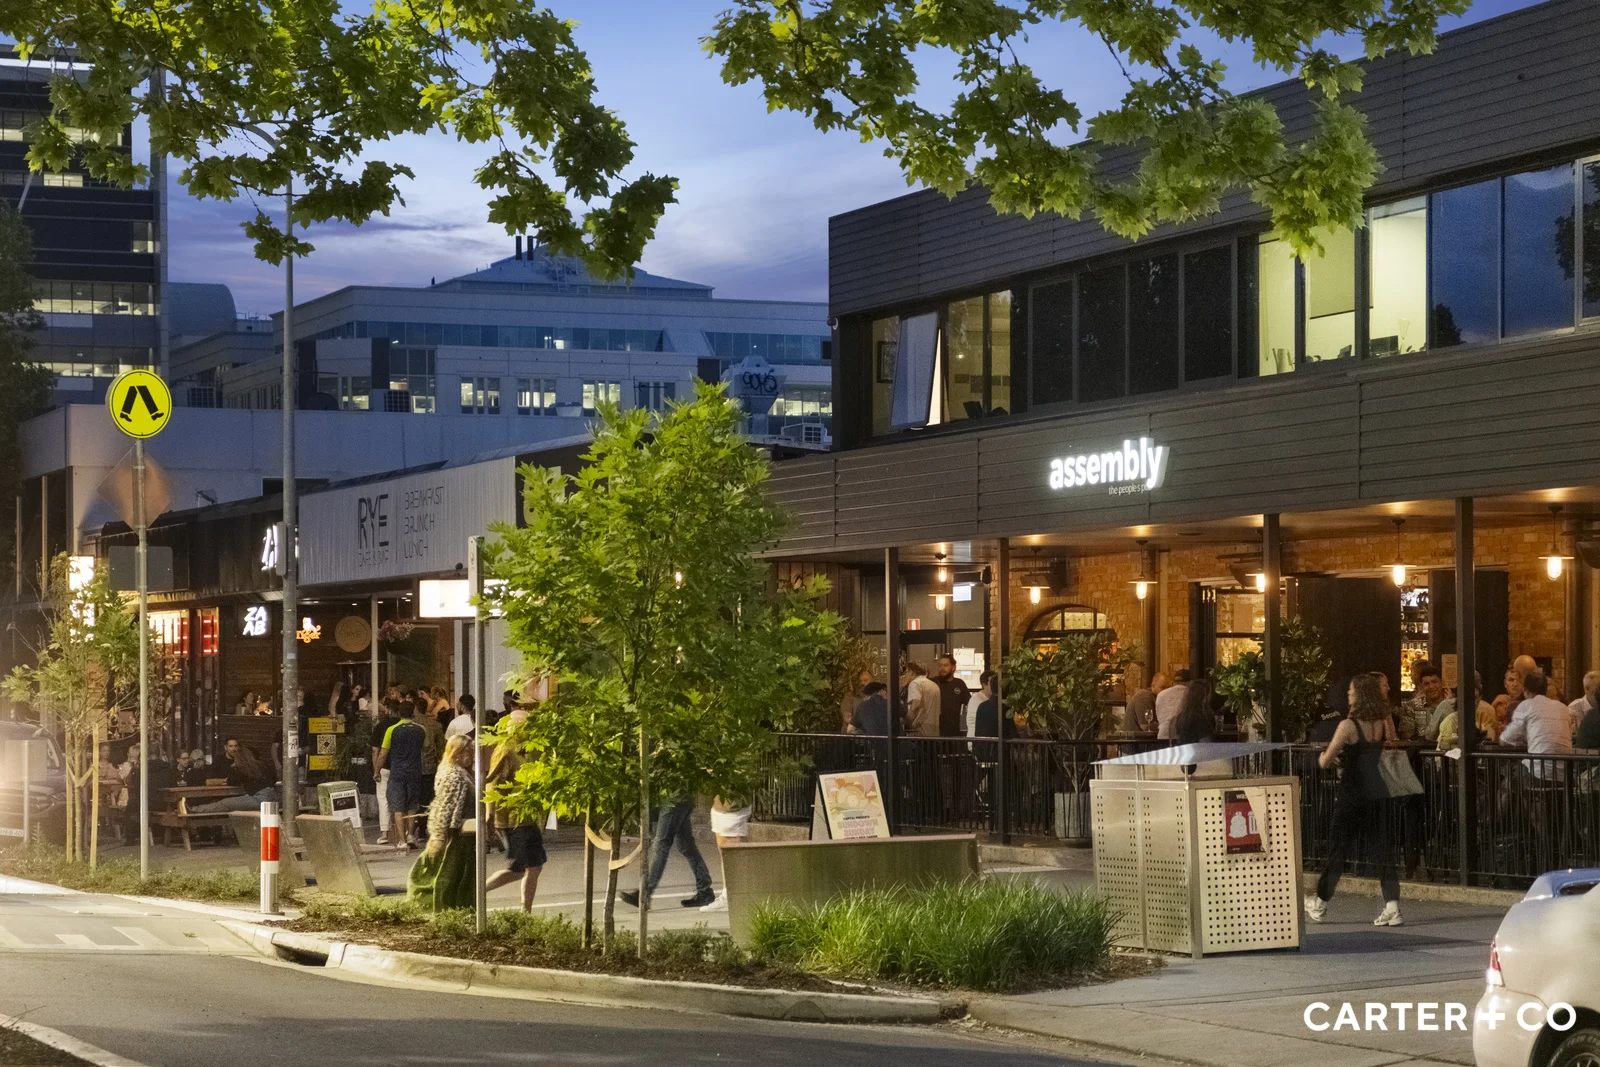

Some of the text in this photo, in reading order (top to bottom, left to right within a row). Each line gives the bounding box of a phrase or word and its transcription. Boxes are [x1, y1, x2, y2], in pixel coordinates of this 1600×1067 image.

[1049, 437, 1167, 490] assembly
[405, 486, 444, 510] BREAKFAST
[1108, 485, 1119, 495] the
[357, 493, 389, 549] RYE
[404, 513, 435, 535] BRUNCH
[404, 539, 429, 559] LUNCH
